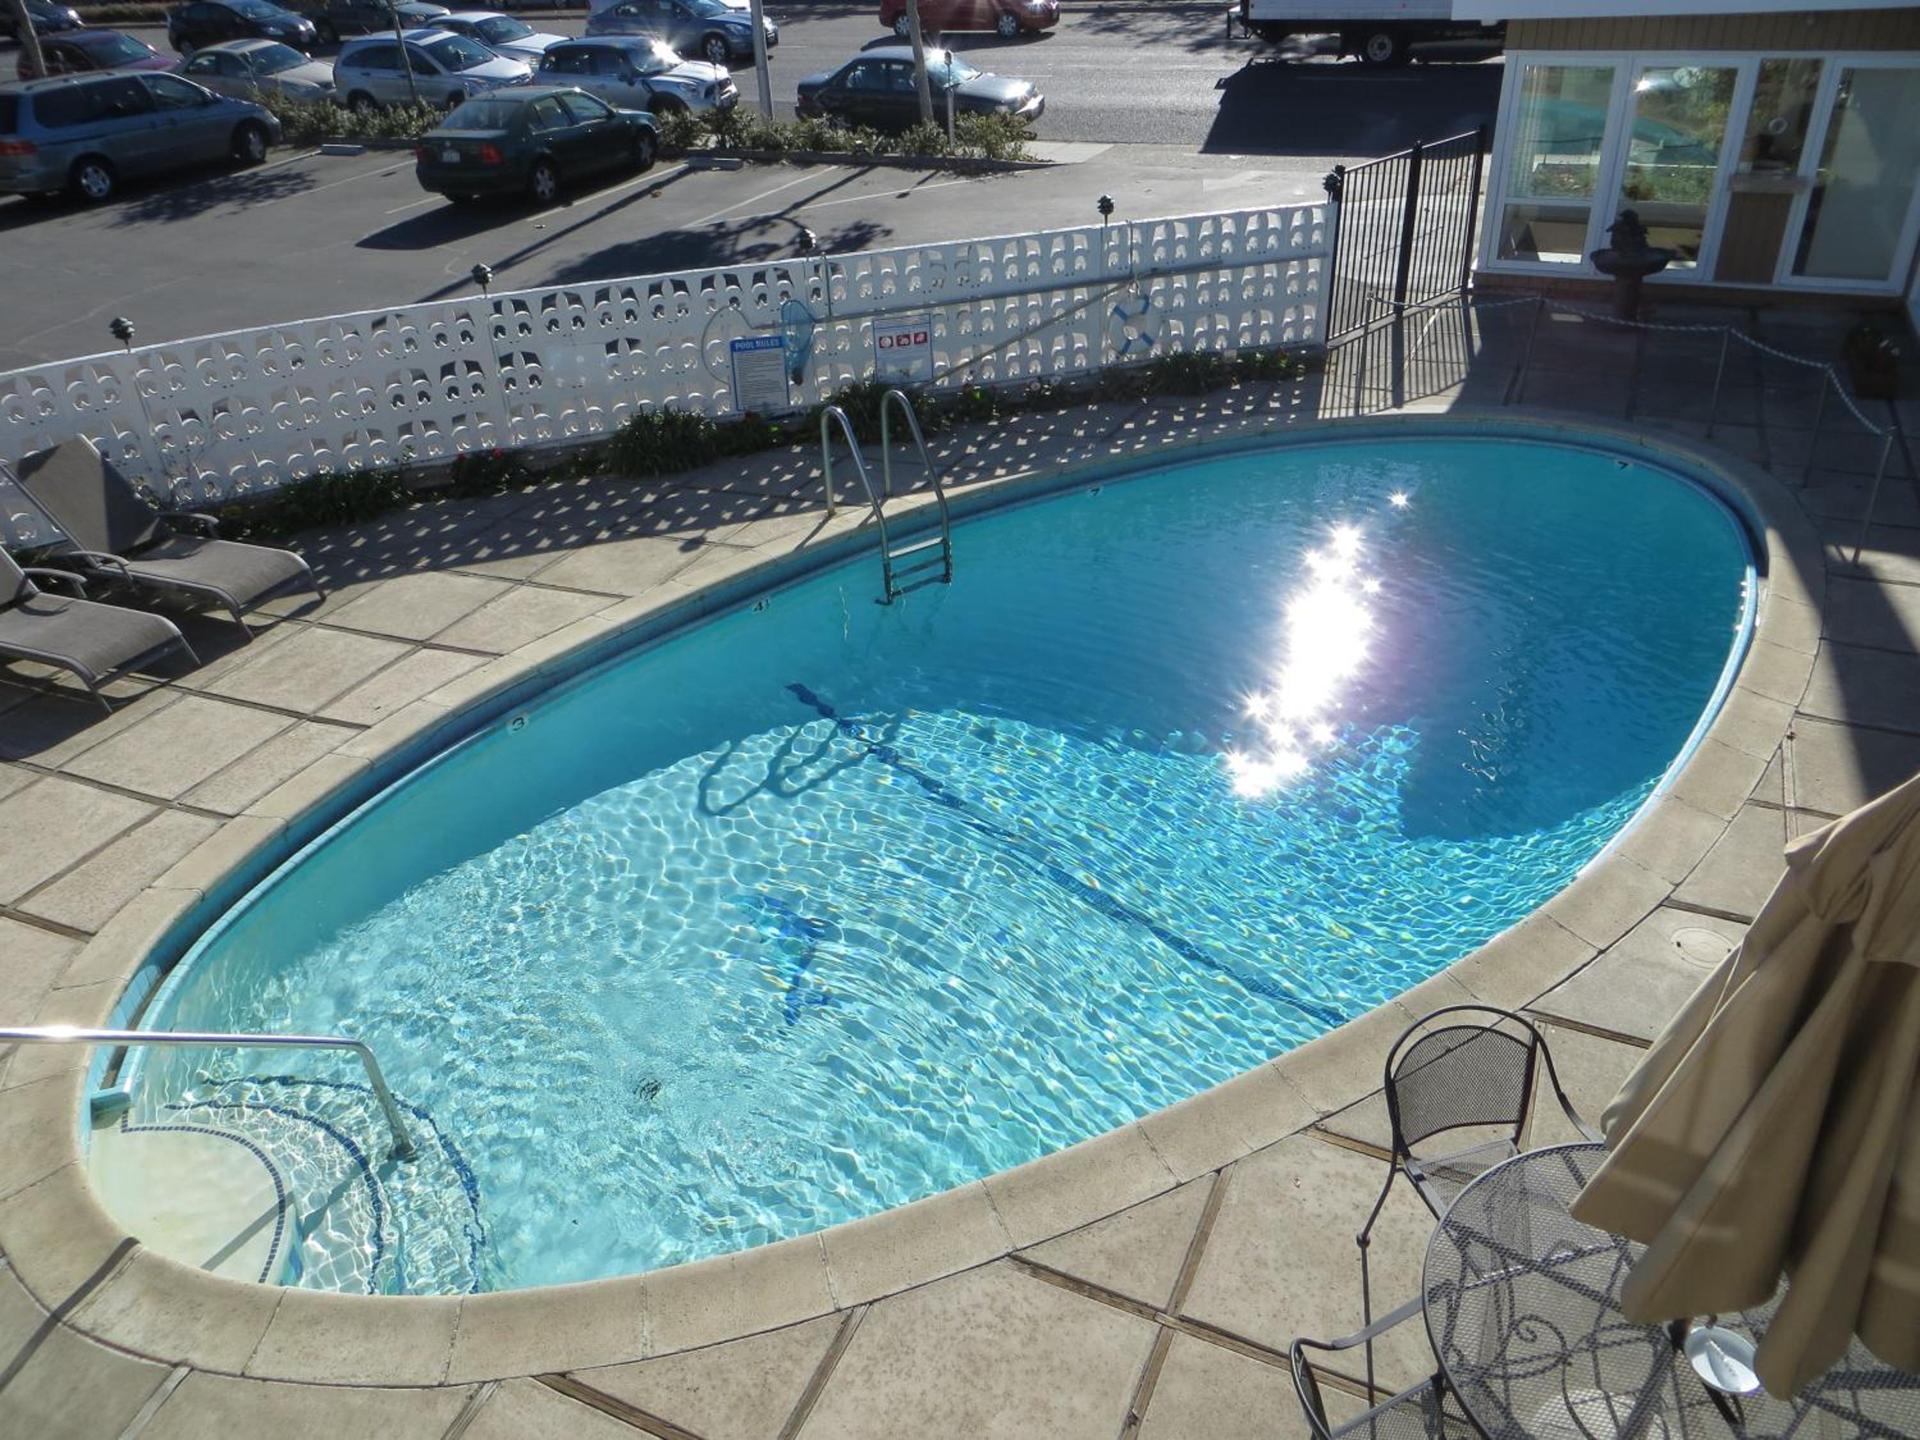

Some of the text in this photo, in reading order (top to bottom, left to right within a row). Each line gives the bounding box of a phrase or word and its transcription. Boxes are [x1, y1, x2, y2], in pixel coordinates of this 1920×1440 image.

[735, 338, 780, 350] POOL RULES
[512, 716, 525, 731] 3
